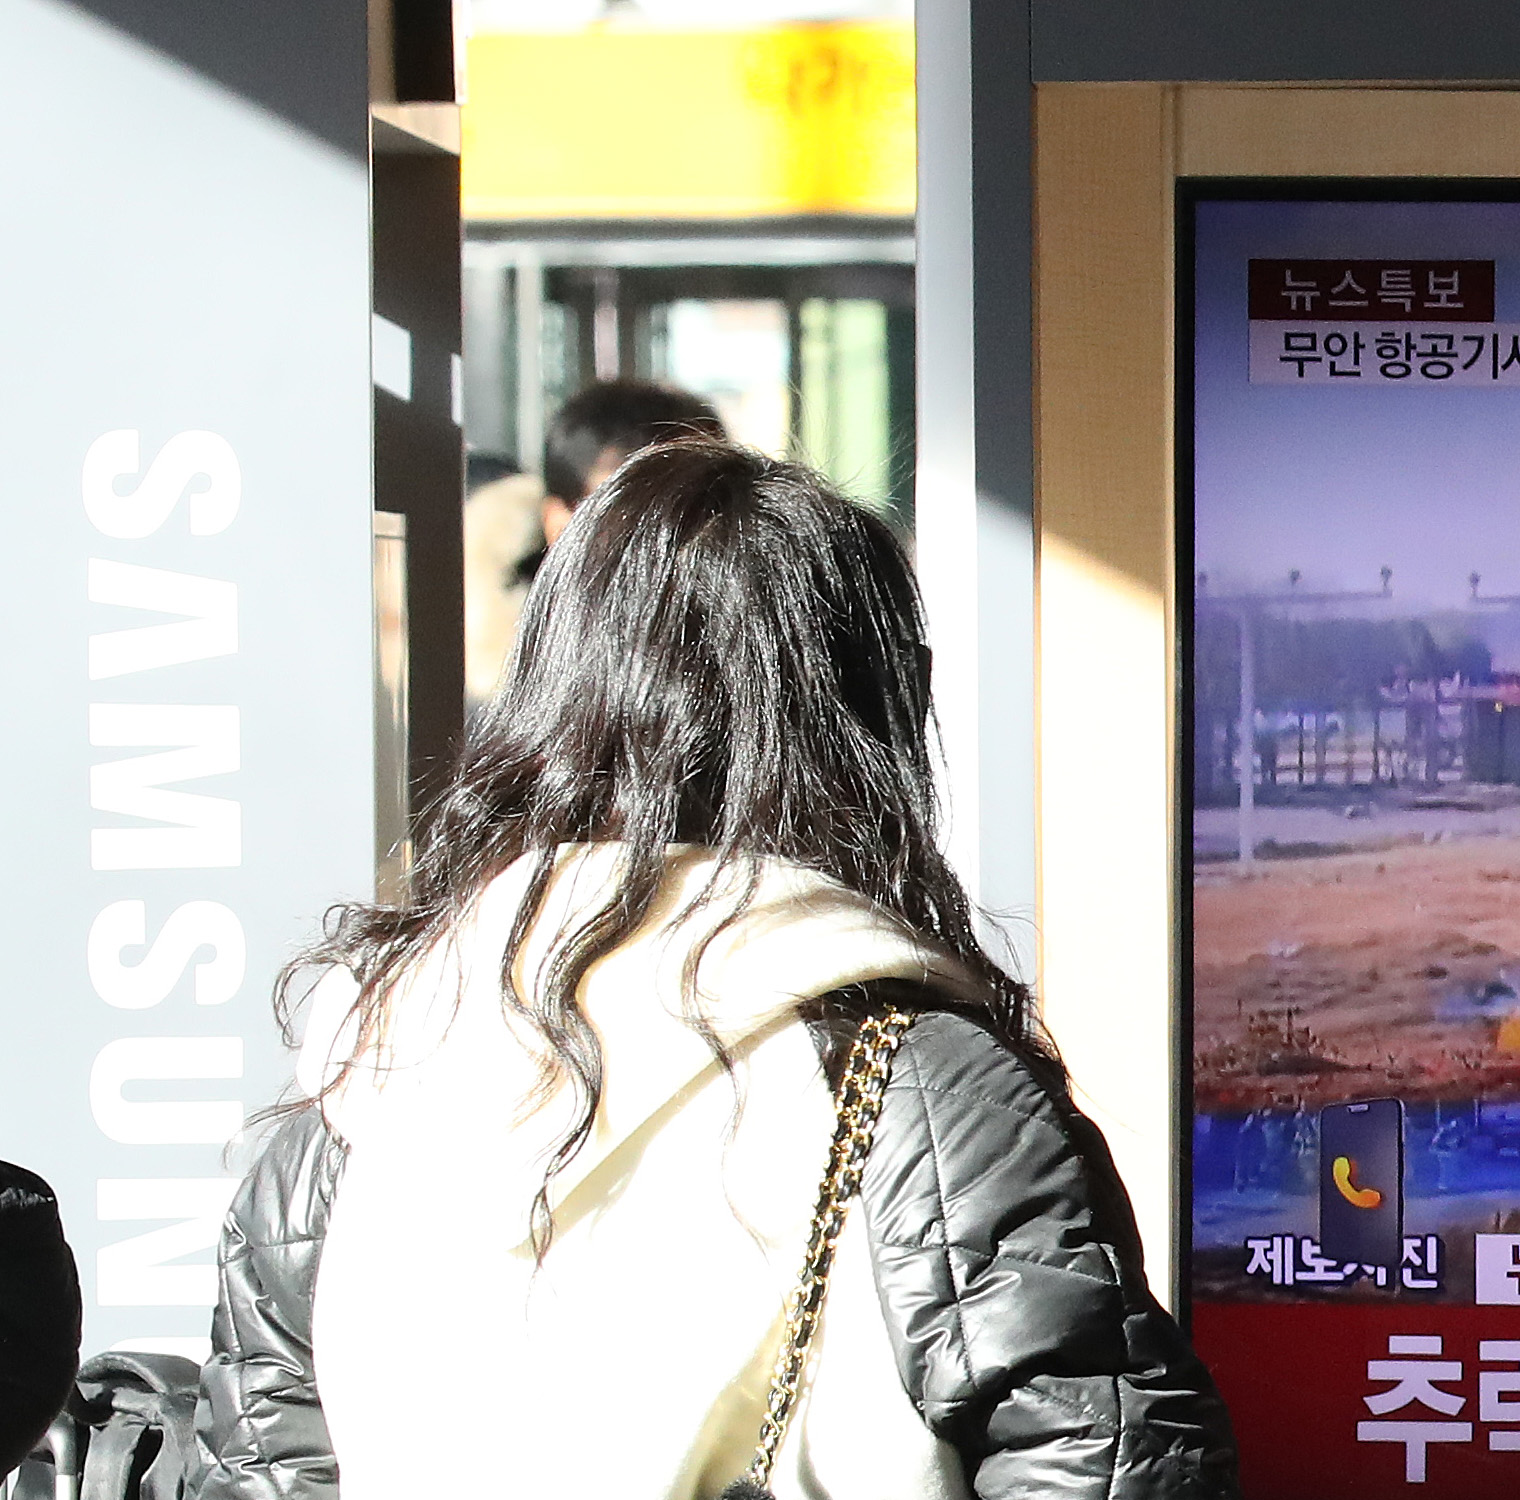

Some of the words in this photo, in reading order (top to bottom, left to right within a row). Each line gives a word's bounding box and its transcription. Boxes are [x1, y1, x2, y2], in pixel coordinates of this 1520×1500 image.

[1281, 269, 1464, 313] 뉴스특보
[1280, 331, 1366, 378] 무안
[81, 427, 248, 1366] SAMSUN
